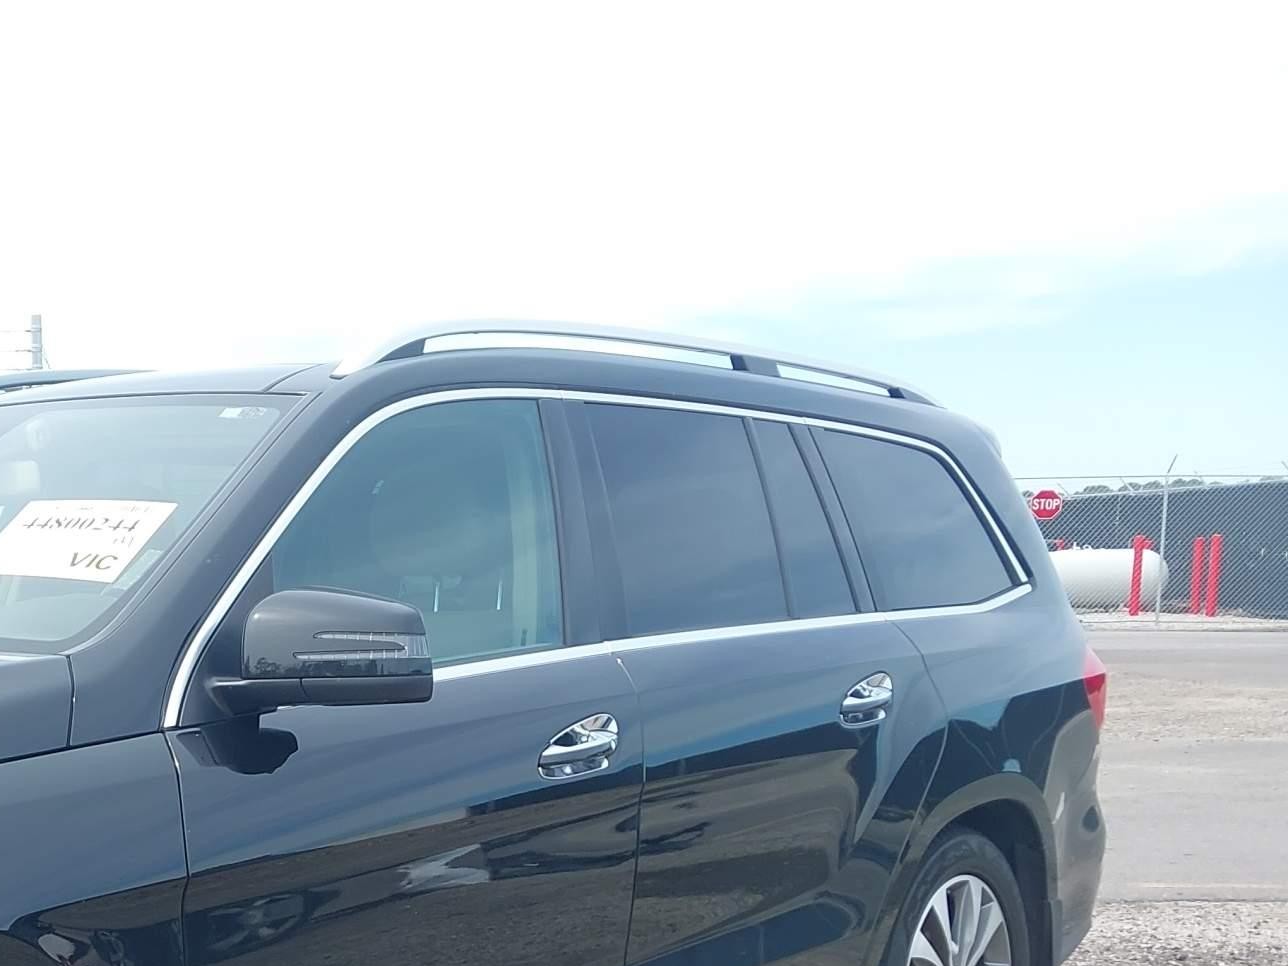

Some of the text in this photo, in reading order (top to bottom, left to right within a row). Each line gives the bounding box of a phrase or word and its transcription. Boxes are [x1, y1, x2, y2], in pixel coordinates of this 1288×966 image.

[1032, 498, 1060, 510] STOP
[23, 516, 141, 532] 44800244
[69, 551, 119, 570] VIC
